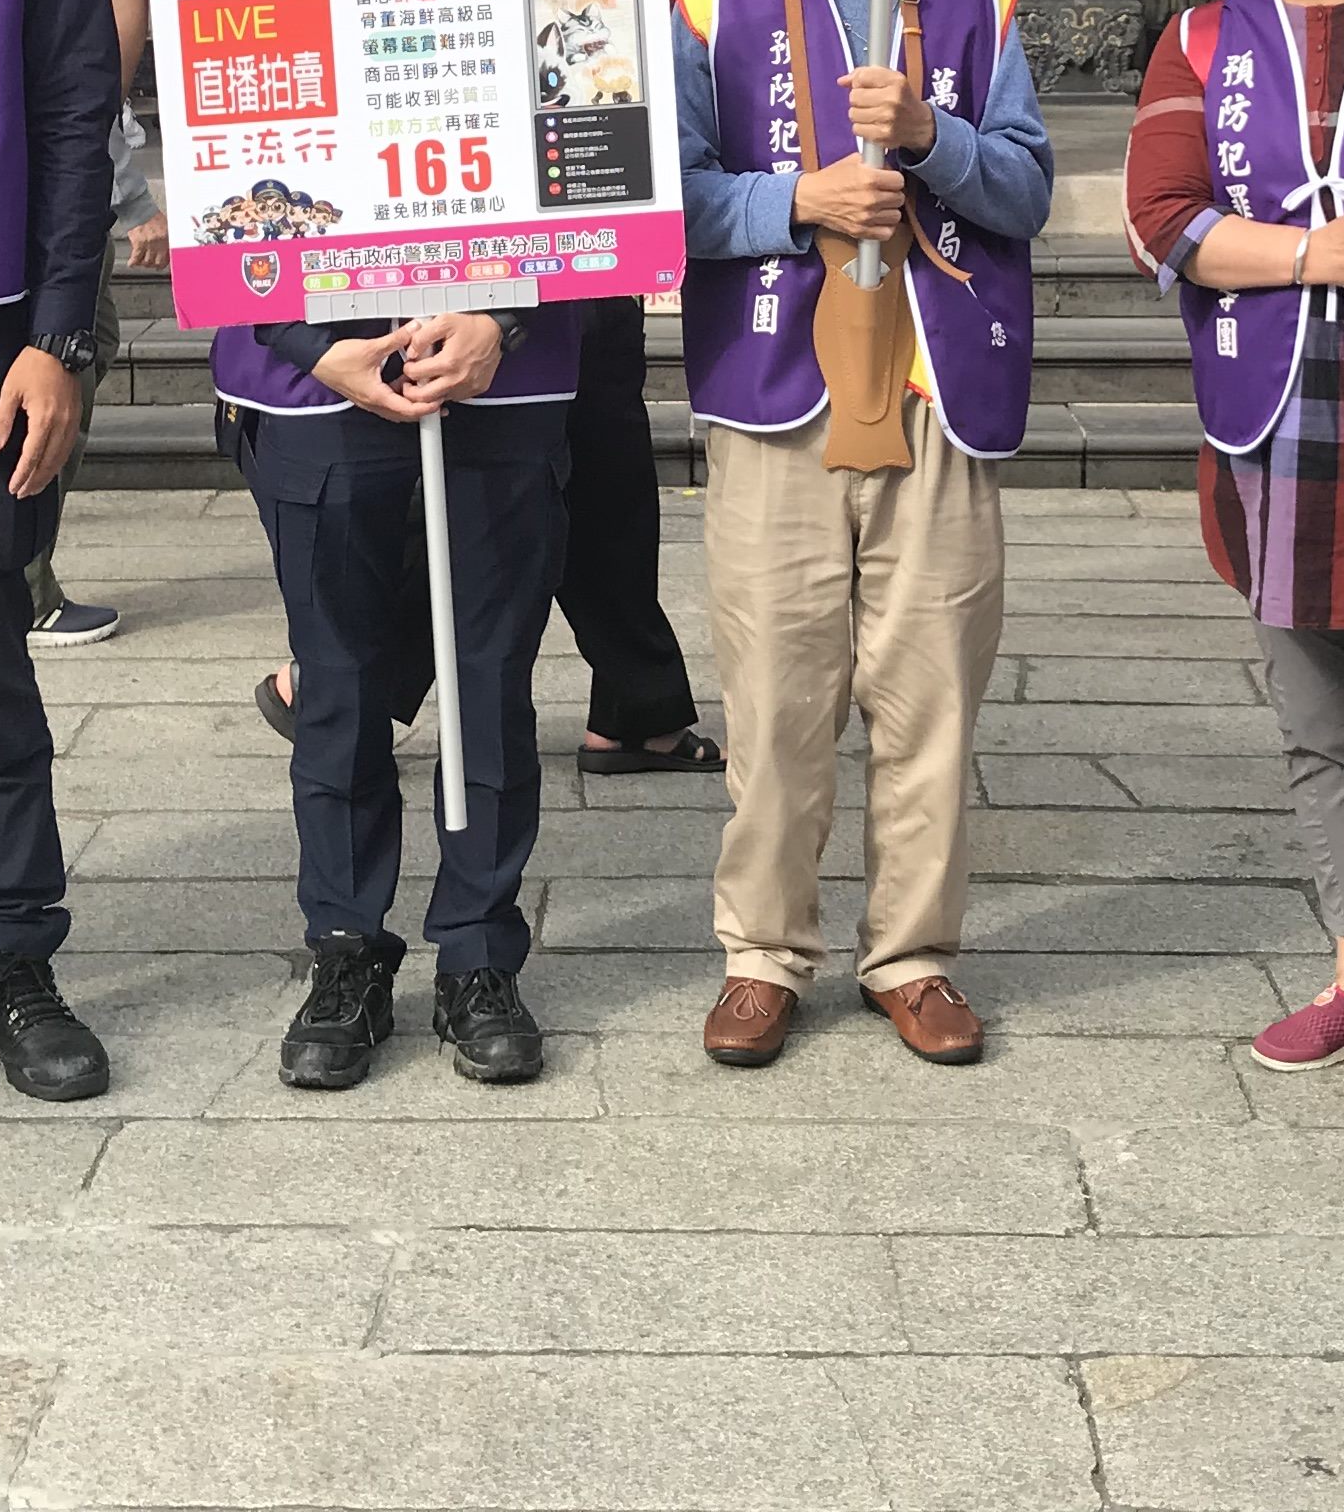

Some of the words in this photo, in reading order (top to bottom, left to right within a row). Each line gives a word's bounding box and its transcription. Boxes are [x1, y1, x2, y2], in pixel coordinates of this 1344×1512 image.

[193, 5, 277, 42] LIVE
[360, 4, 493, 29] 骨董海鮮高級品
[362, 31, 495, 56] 螢幕鑑賞難辨明
[193, 51, 326, 116] 直播拍賣
[366, 85, 498, 110] 可能收到劣質品
[368, 112, 500, 137] 付款方式再確定
[192, 129, 337, 173] 正流行
[377, 136, 492, 198] 165
[373, 195, 506, 221] 避免財損徒傷心
[302, 240, 463, 272] 臺北市政府警察局
[469, 233, 550, 259] 萬華分局
[555, 229, 618, 252] 關心您
